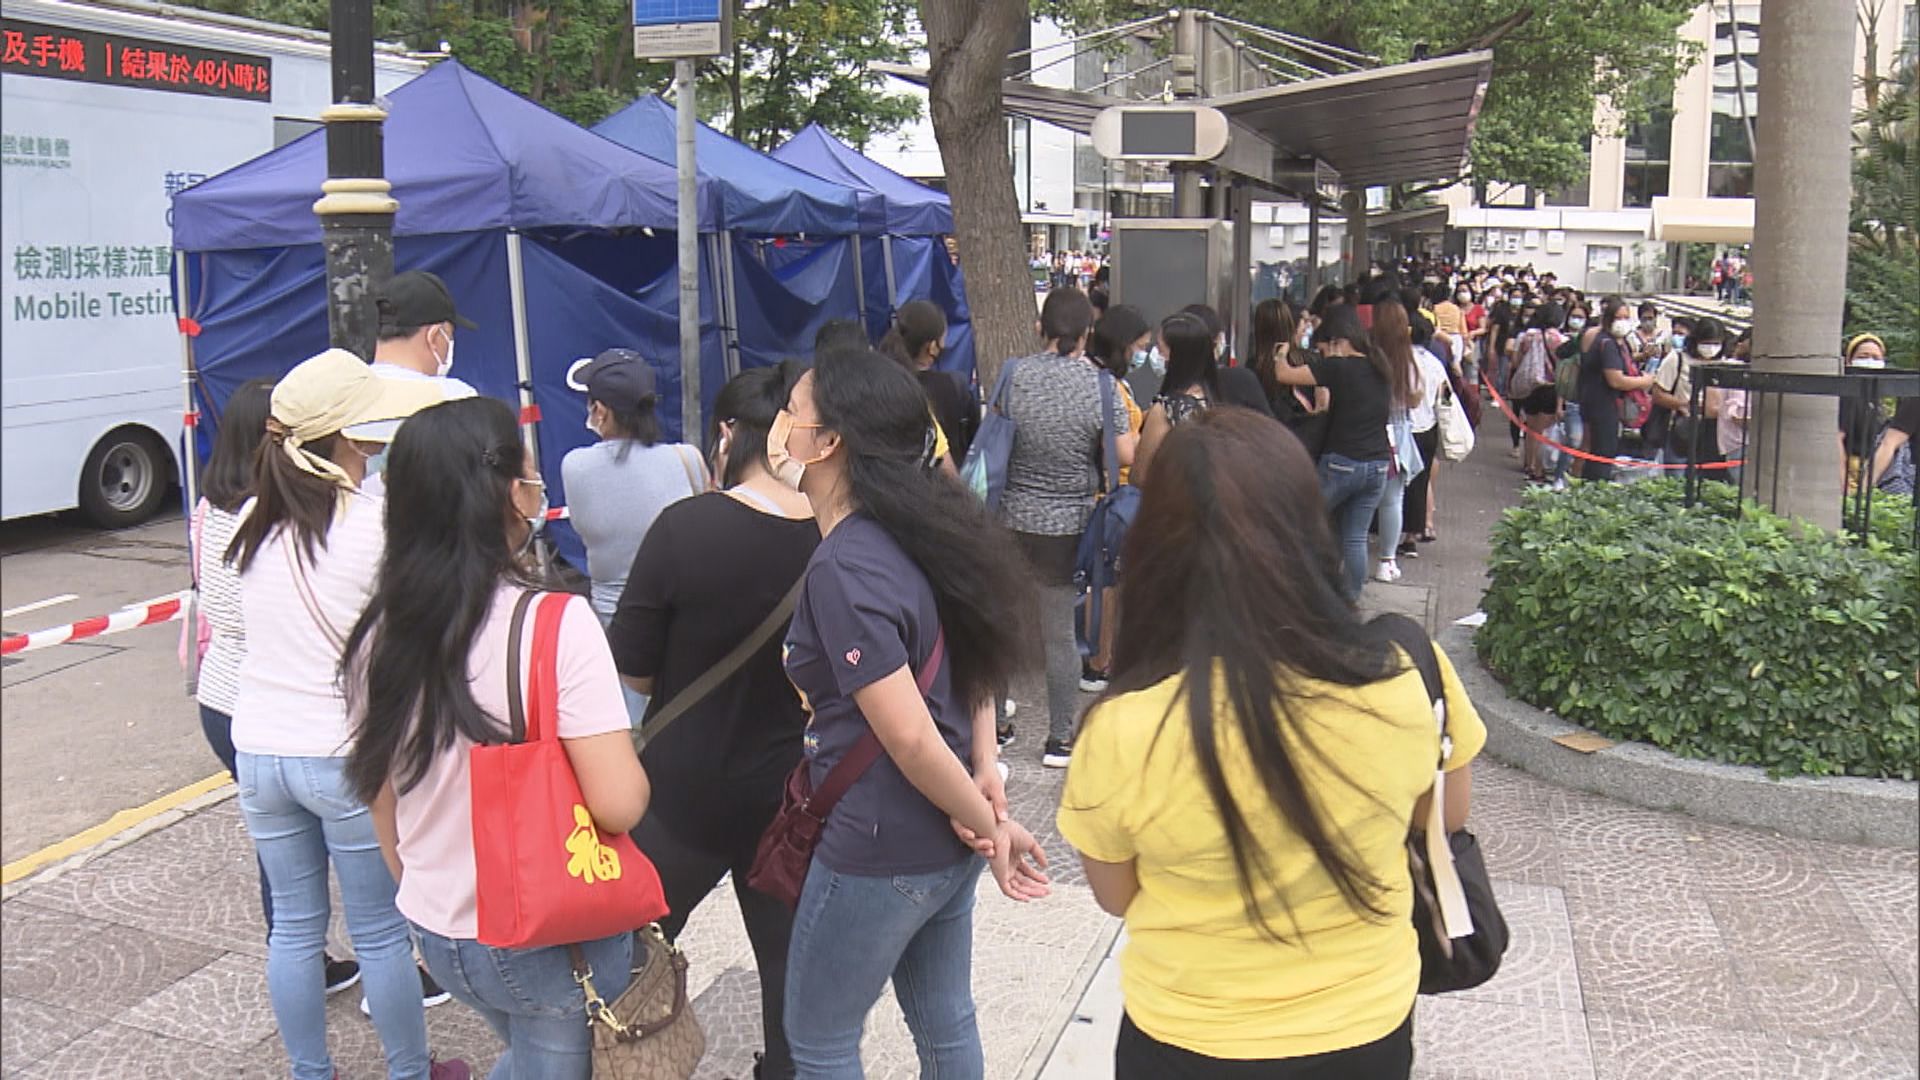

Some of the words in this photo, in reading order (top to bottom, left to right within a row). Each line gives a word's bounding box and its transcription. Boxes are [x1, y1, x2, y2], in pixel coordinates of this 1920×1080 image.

[2, 30, 86, 72] 及手機
[14, 291, 101, 321] Mobile
